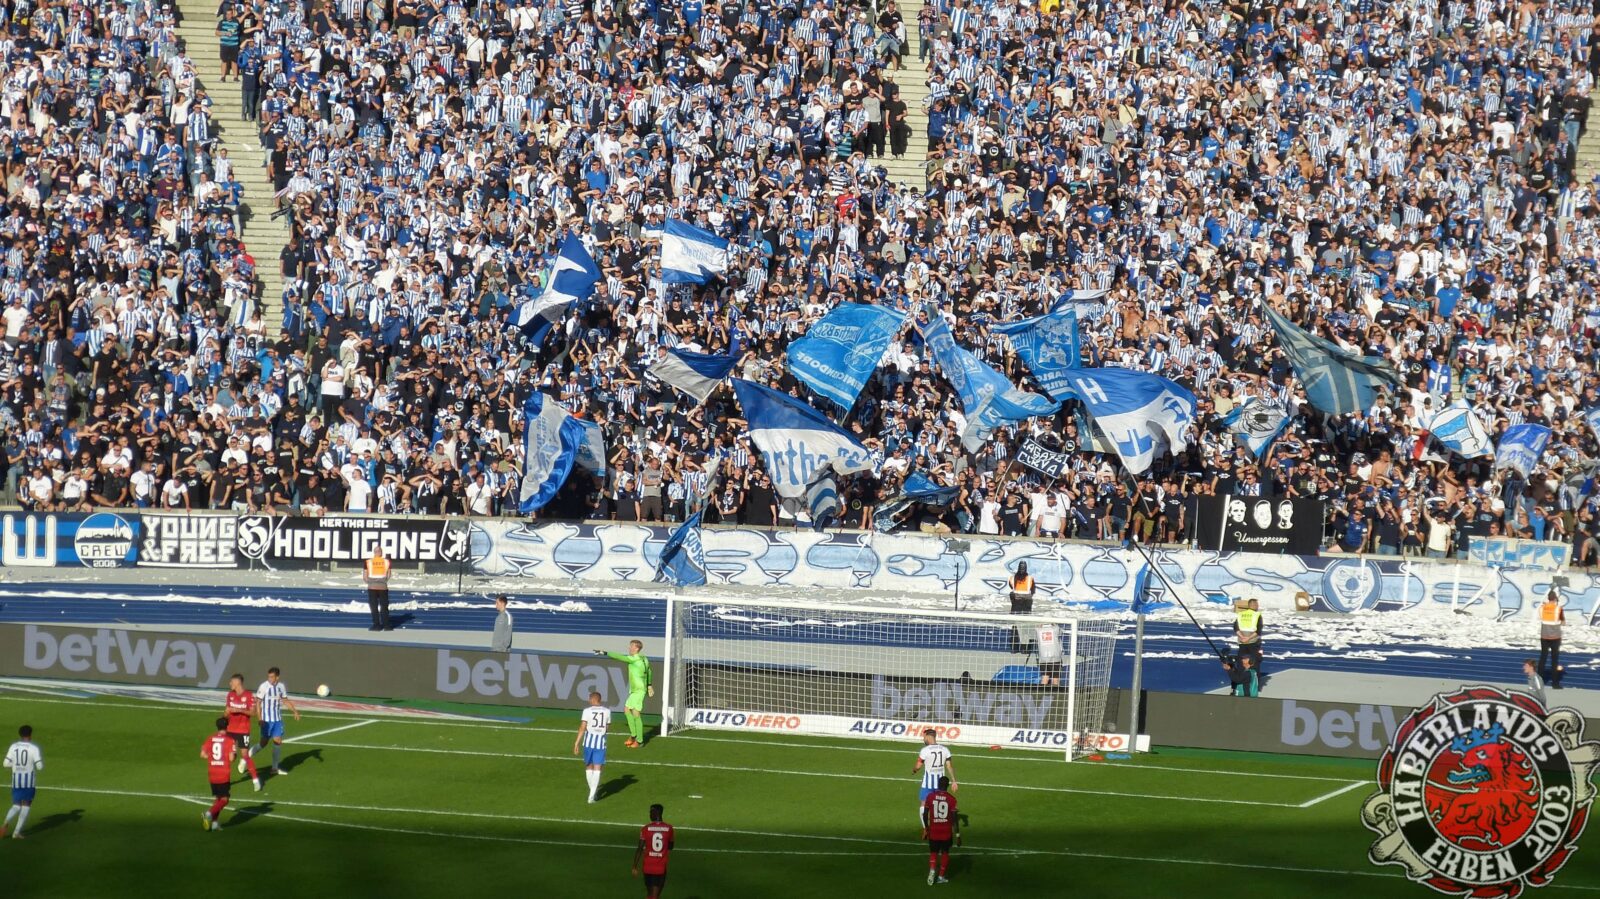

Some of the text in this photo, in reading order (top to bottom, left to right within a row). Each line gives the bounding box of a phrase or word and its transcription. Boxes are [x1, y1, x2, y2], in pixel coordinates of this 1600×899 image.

[141, 515, 236, 540] YOUNG
[319, 518, 389, 529] HERTHA BSC
[274, 529, 438, 560] HOOLIGANS
[1234, 531, 1290, 546] Unvergessen
[24, 624, 235, 688] betway
[436, 649, 631, 713] betway
[871, 674, 1054, 730] betway
[591, 711, 605, 728] 31
[690, 710, 801, 730] AUTOHERO
[1281, 699, 1397, 751] bet
[14, 748, 28, 767] 10
[212, 742, 222, 761] 9
[930, 750, 944, 768] 21
[932, 800, 949, 819] 19
[652, 832, 663, 852] 6
